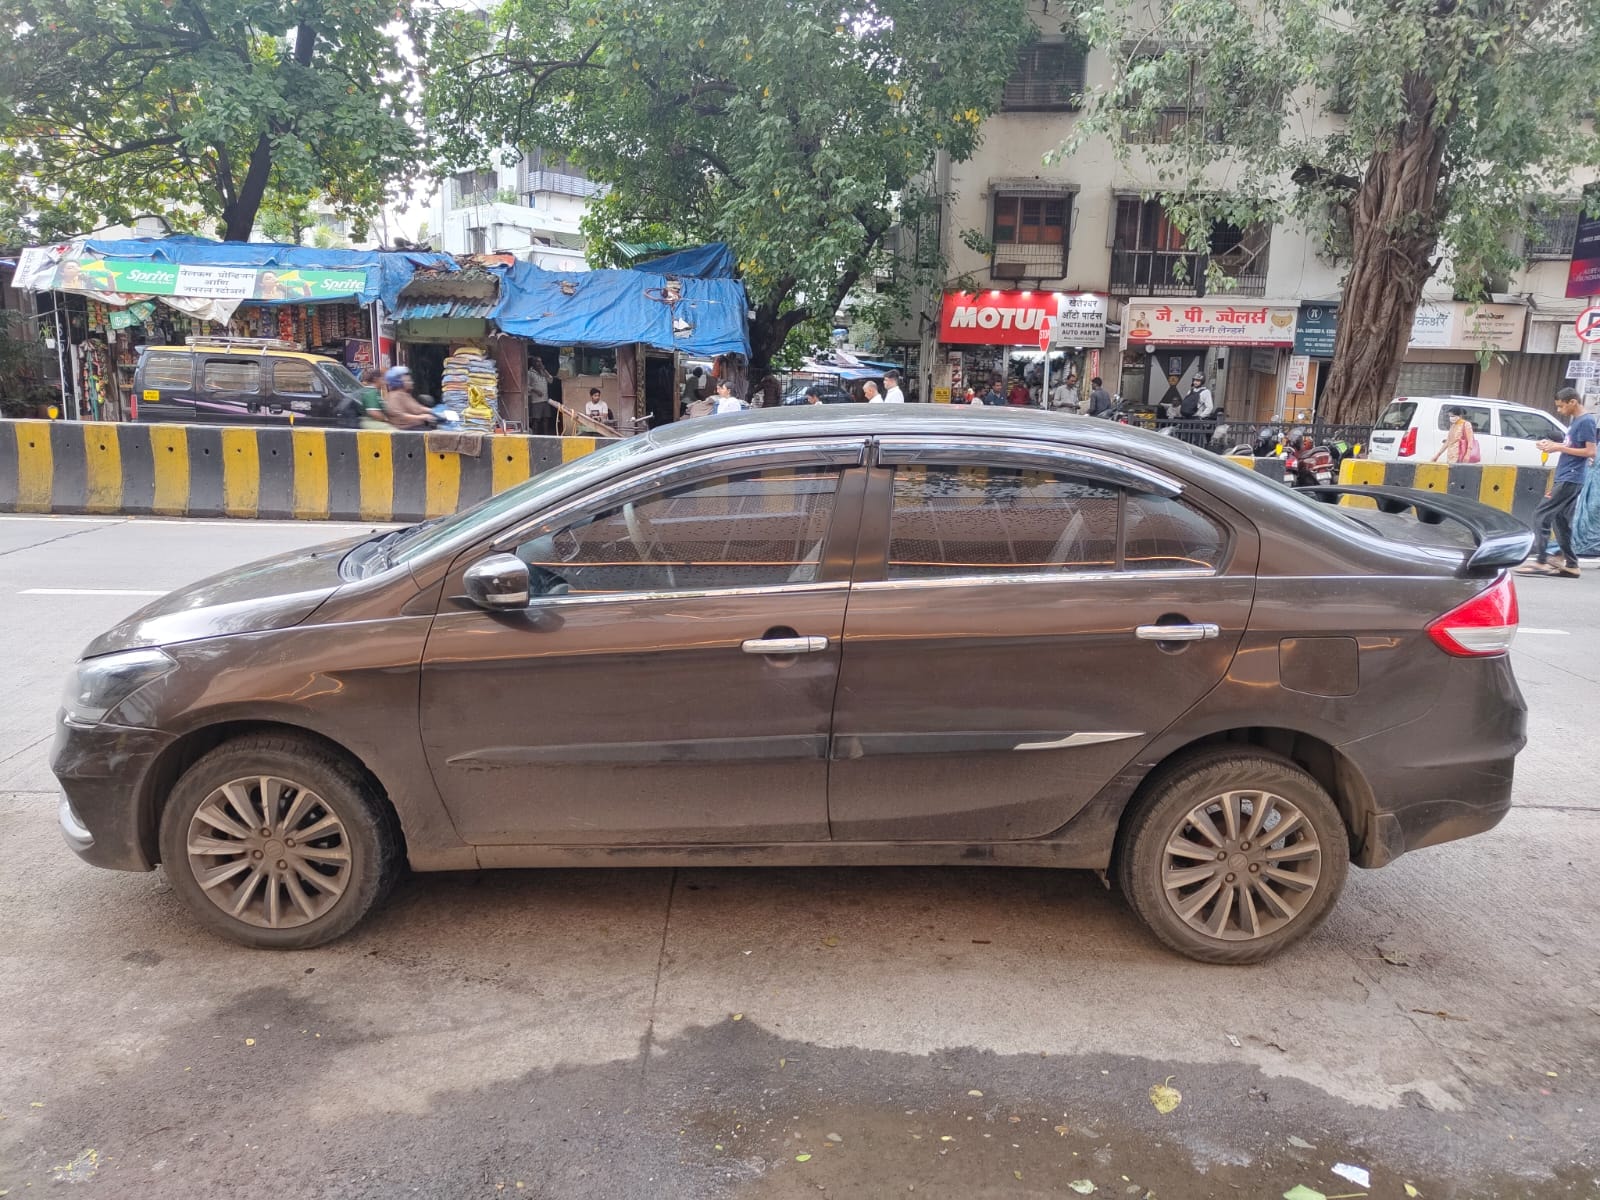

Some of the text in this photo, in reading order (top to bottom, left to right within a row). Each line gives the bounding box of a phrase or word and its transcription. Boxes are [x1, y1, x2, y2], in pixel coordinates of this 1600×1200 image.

[126, 269, 175, 282] Sprite
[320, 278, 365, 291] Sprite
[1062, 309, 1080, 320] ऑटो
[1215, 306, 1269, 324] ज्वेलर्स
[1039, 329, 1050, 339] STOP
